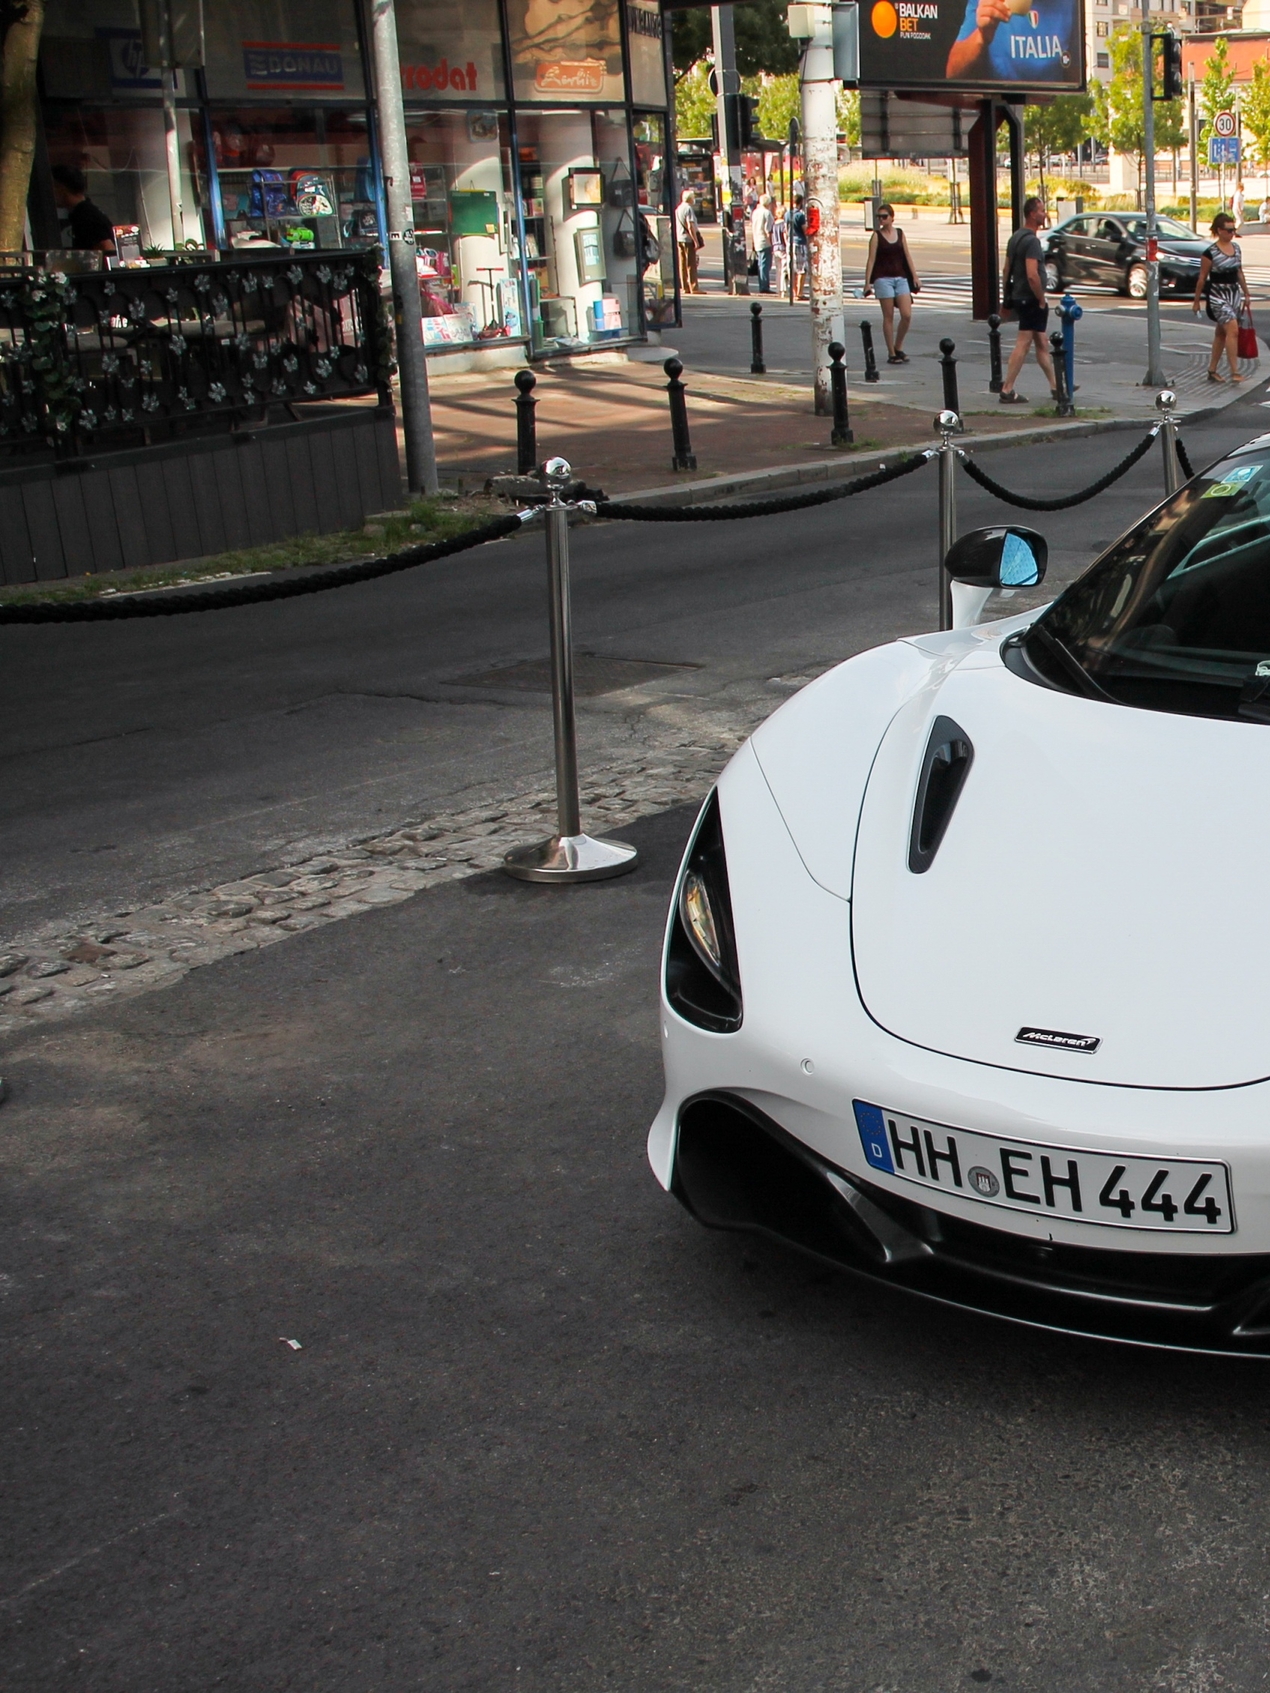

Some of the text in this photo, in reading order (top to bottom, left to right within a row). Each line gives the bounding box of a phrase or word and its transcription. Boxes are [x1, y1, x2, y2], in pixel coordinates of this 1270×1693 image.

[899, 2, 938, 19] BALKAN
[899, 17, 919, 32] BET
[1010, 35, 1062, 59] ITALIA
[401, 58, 477, 91] rodat
[1219, 118, 1232, 131] 30
[1023, 1032, 1088, 1047] McLaren
[870, 1143, 883, 1158] D
[887, 1118, 1222, 1224] HH EH 444
